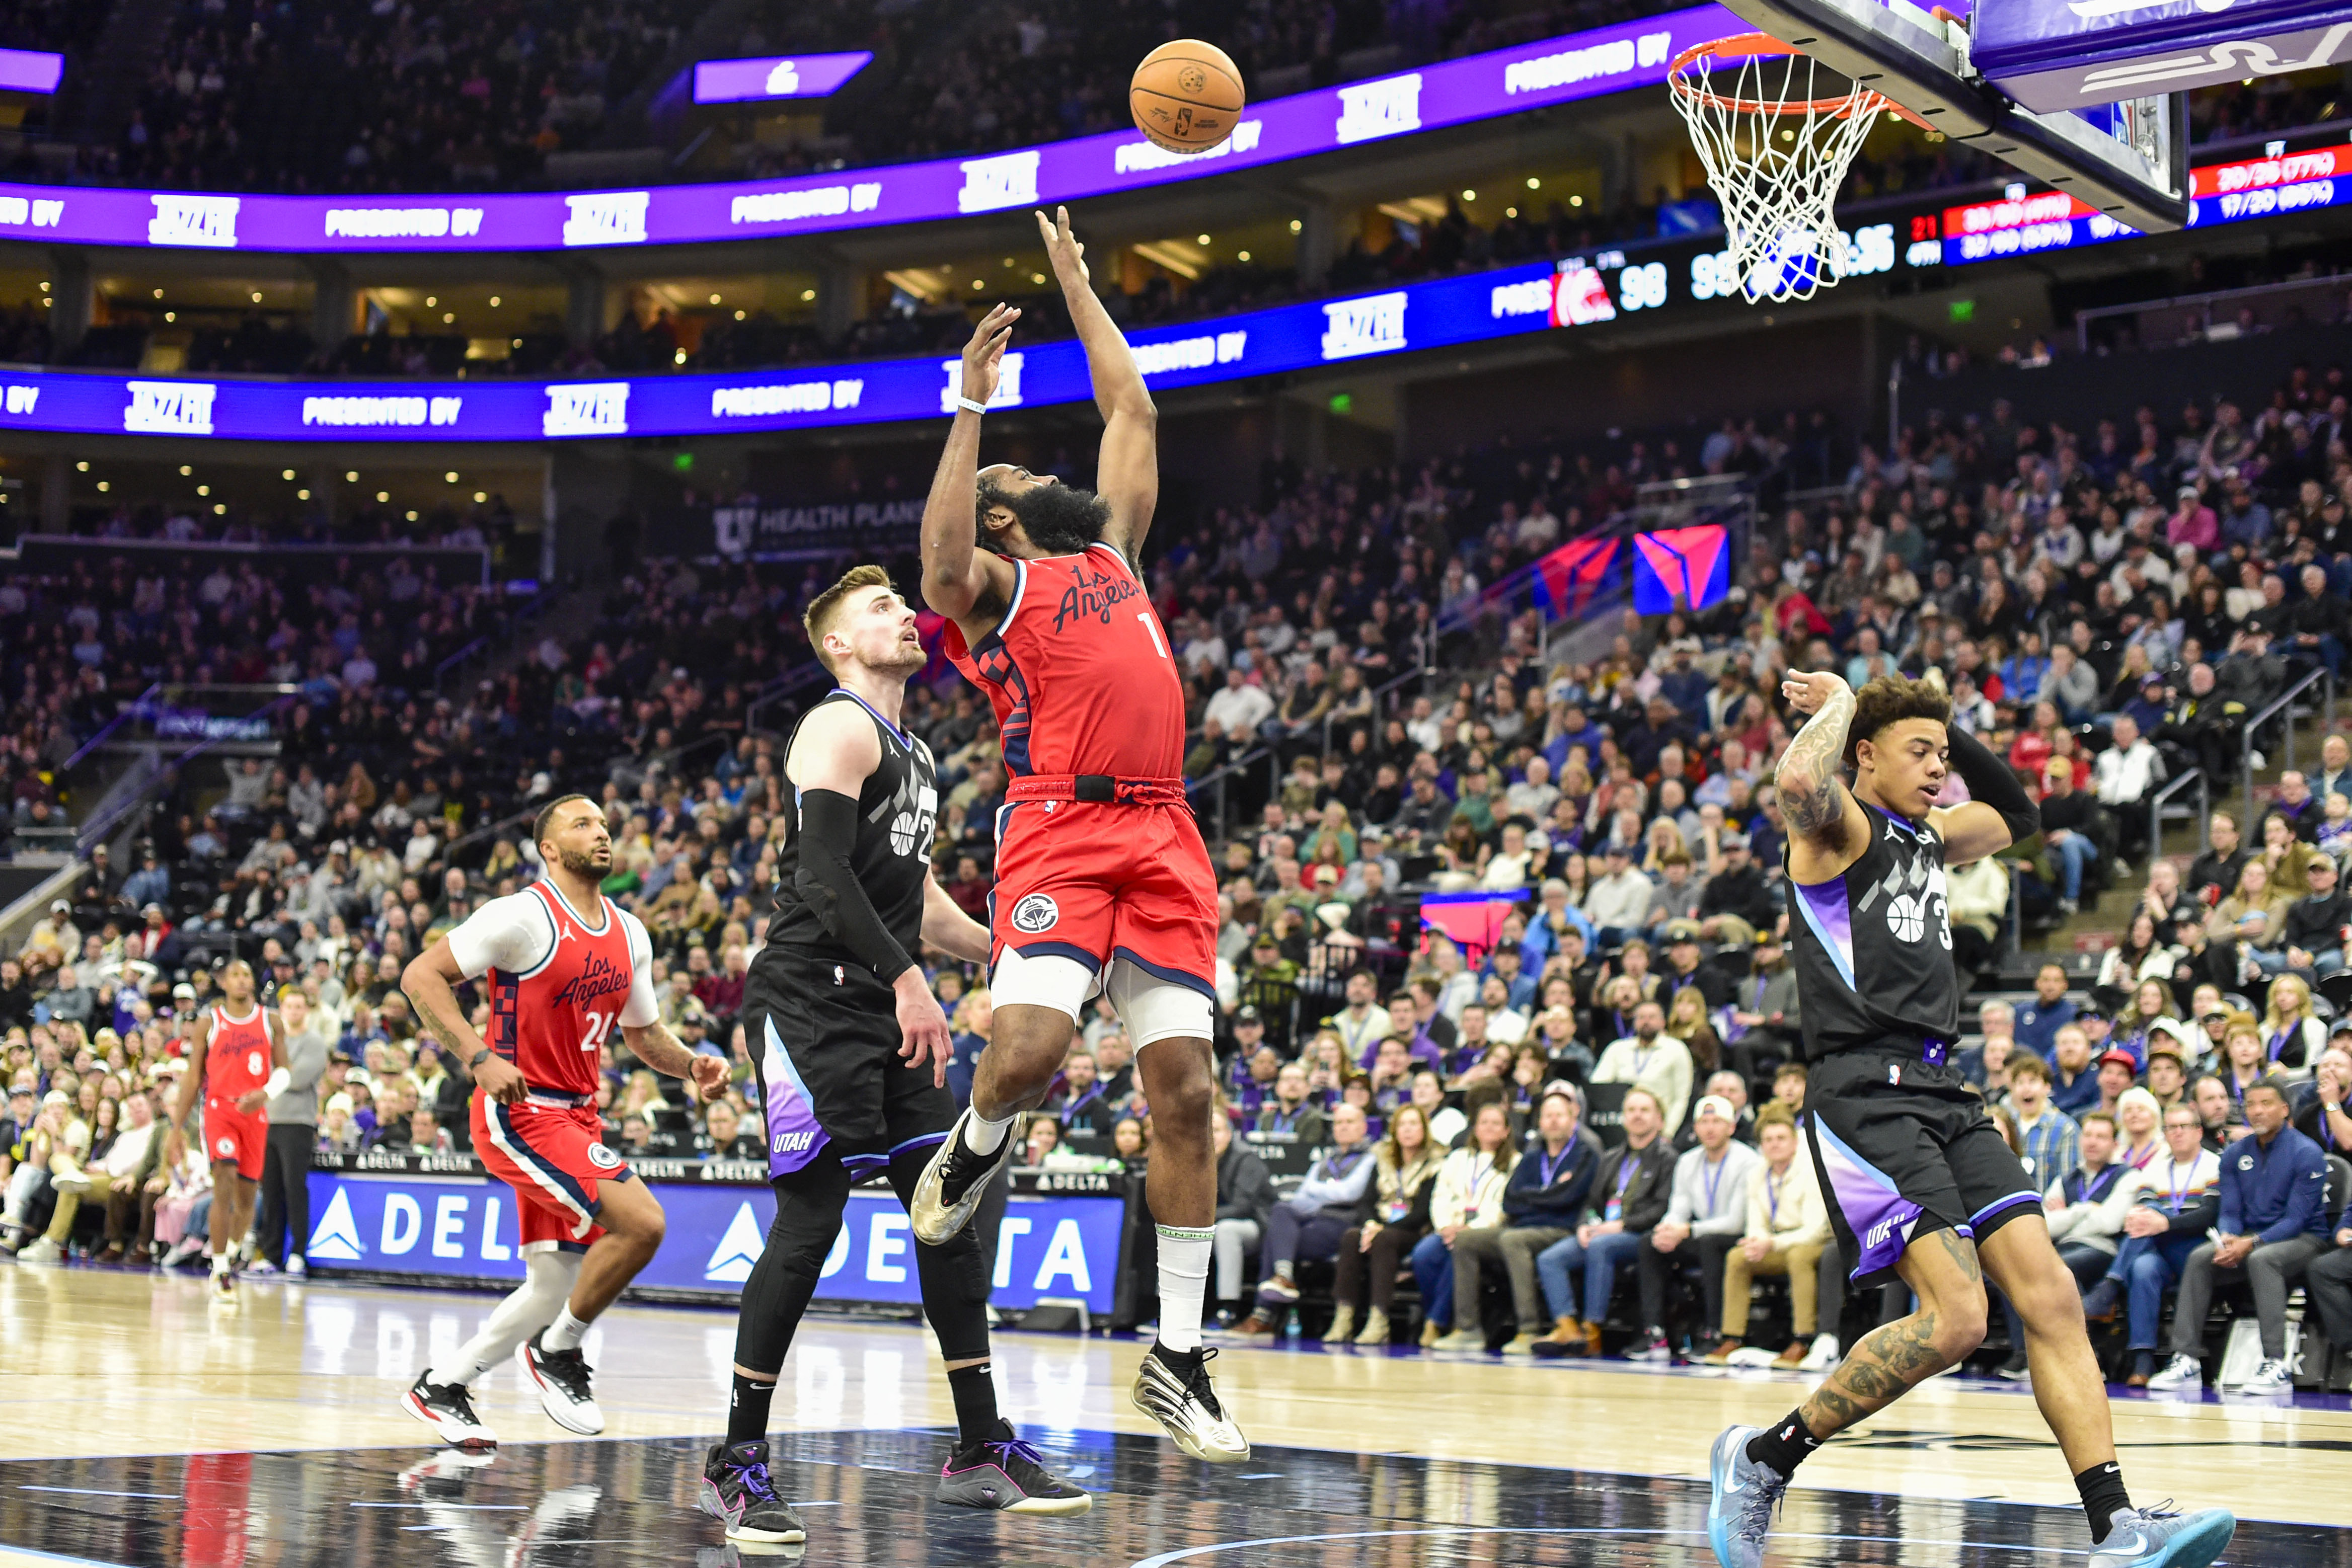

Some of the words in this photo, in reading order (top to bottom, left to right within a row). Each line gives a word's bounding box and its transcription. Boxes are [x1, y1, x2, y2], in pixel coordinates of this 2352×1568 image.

[1911, 214, 1937, 241] 21
[1620, 262, 1666, 311] 98
[1131, 336, 1215, 375] SENTED
[1218, 332, 1246, 362] BY
[430, 398, 461, 425] BY
[833, 379, 863, 408] BY
[761, 505, 849, 533] HEALTH
[1137, 612, 1167, 658] 1
[918, 816, 936, 864] 2
[1933, 899, 1953, 950] 3
[581, 951, 612, 980] Los
[553, 966, 629, 1012] Angeles
[581, 1011, 615, 1051] 24
[248, 1051, 263, 1076] 8
[773, 1131, 814, 1153] UTAH
[367, 1153, 408, 1169] DELTA
[638, 1160, 686, 1178] DELTA
[714, 1162, 763, 1181] DELTA
[1053, 1173, 1109, 1191] DELTA
[380, 1192, 511, 1261] DEL
